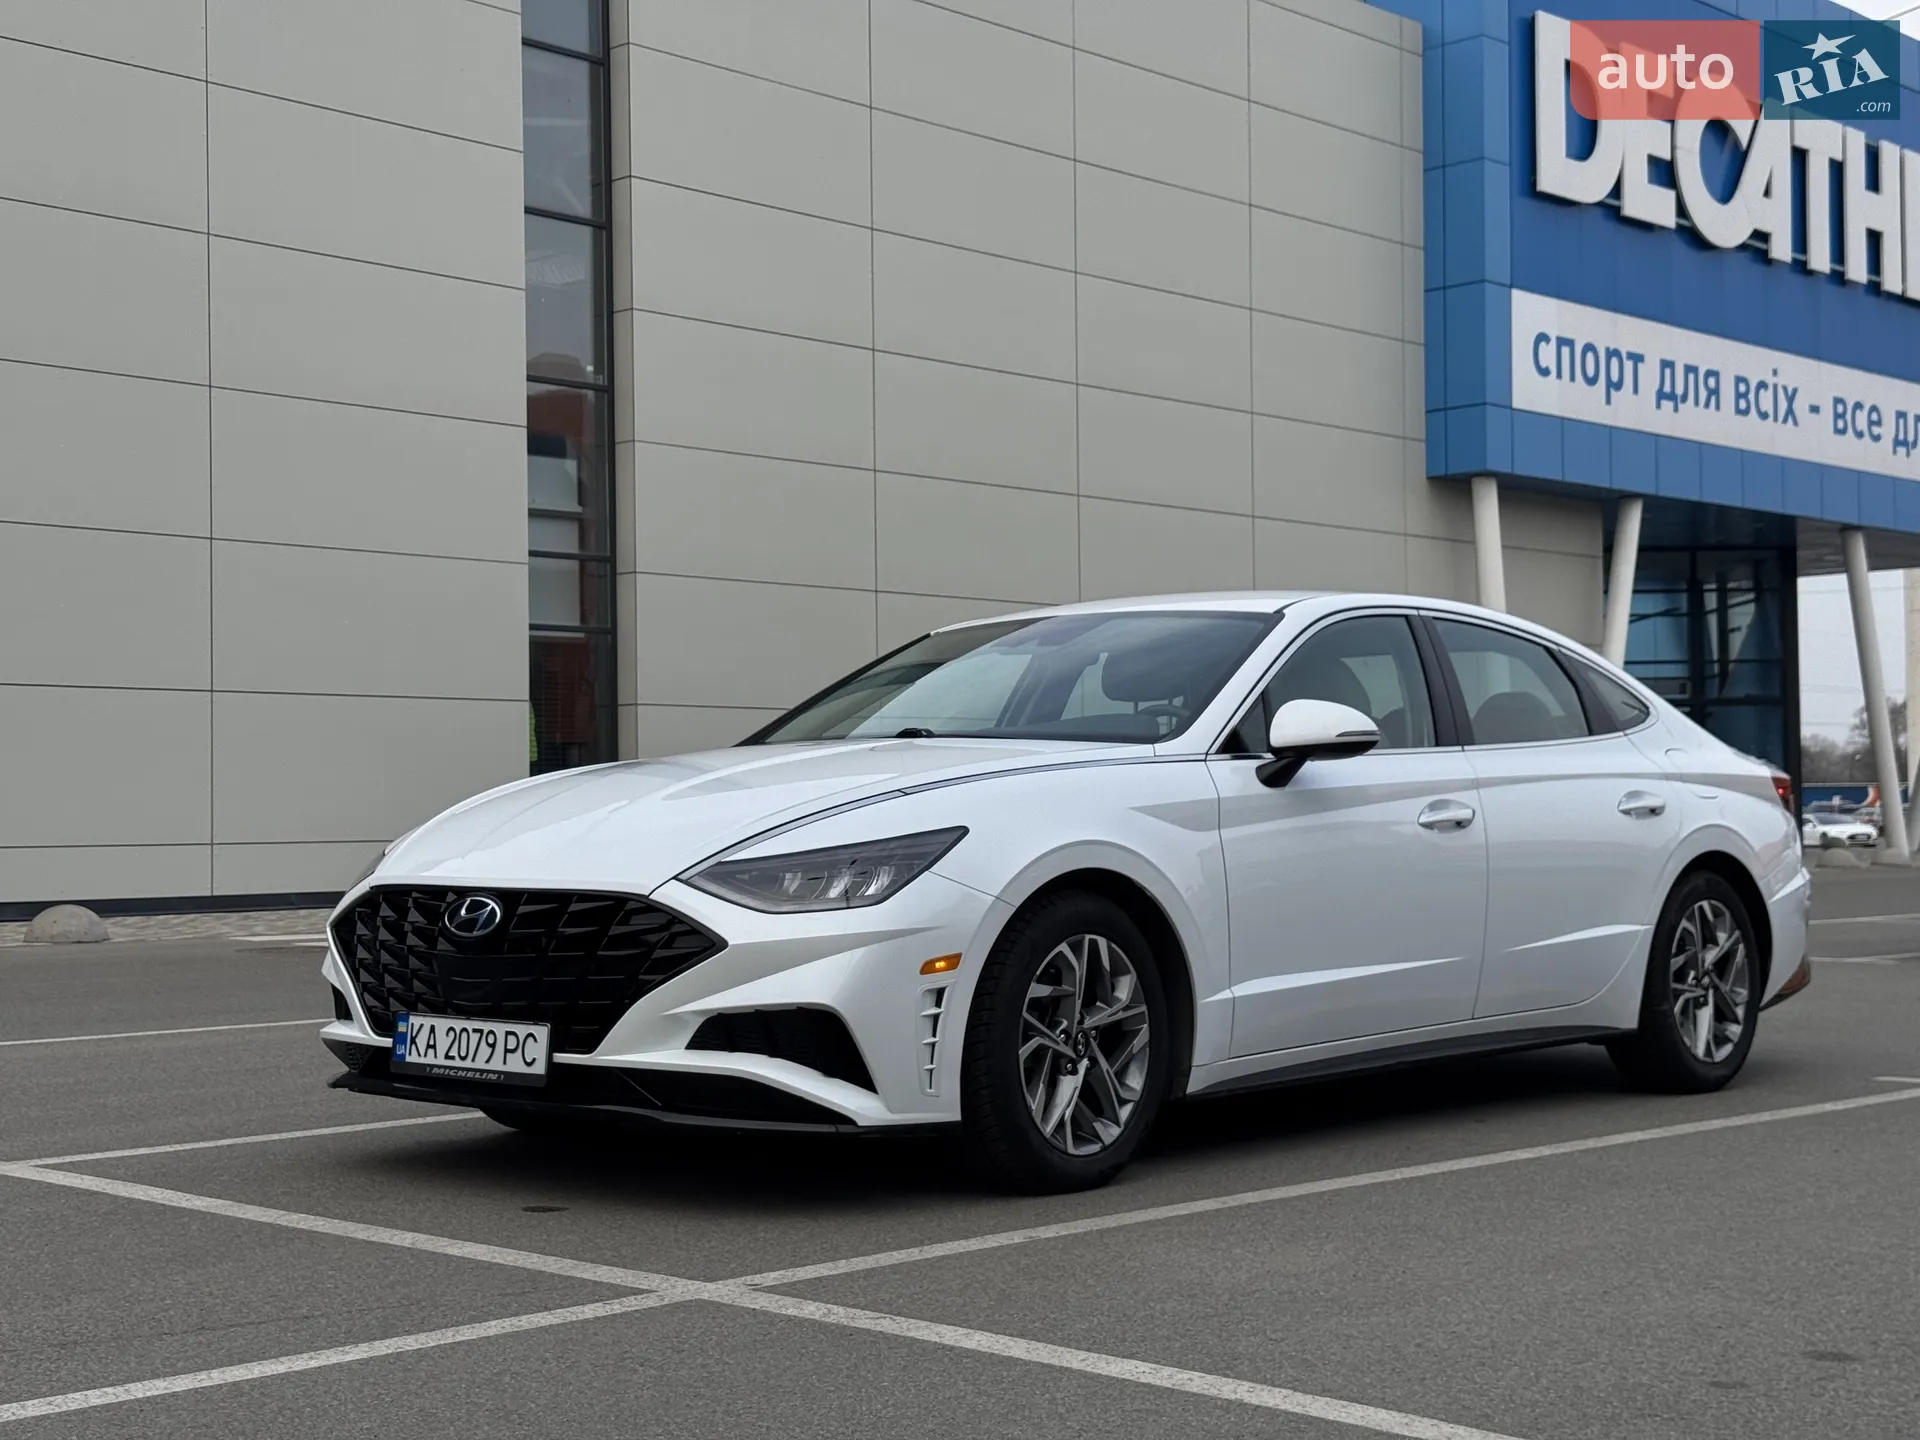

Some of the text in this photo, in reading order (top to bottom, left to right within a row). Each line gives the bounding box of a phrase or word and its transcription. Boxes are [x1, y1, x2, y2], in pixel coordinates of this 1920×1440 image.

[1532, 331, 1645, 404] спорт
[1655, 358, 1721, 413] для
[1734, 368, 1799, 427] всіх
[1832, 396, 1882, 443] все
[444, 1026, 497, 1064] 2079
[431, 1067, 499, 1080] MICHELIN
